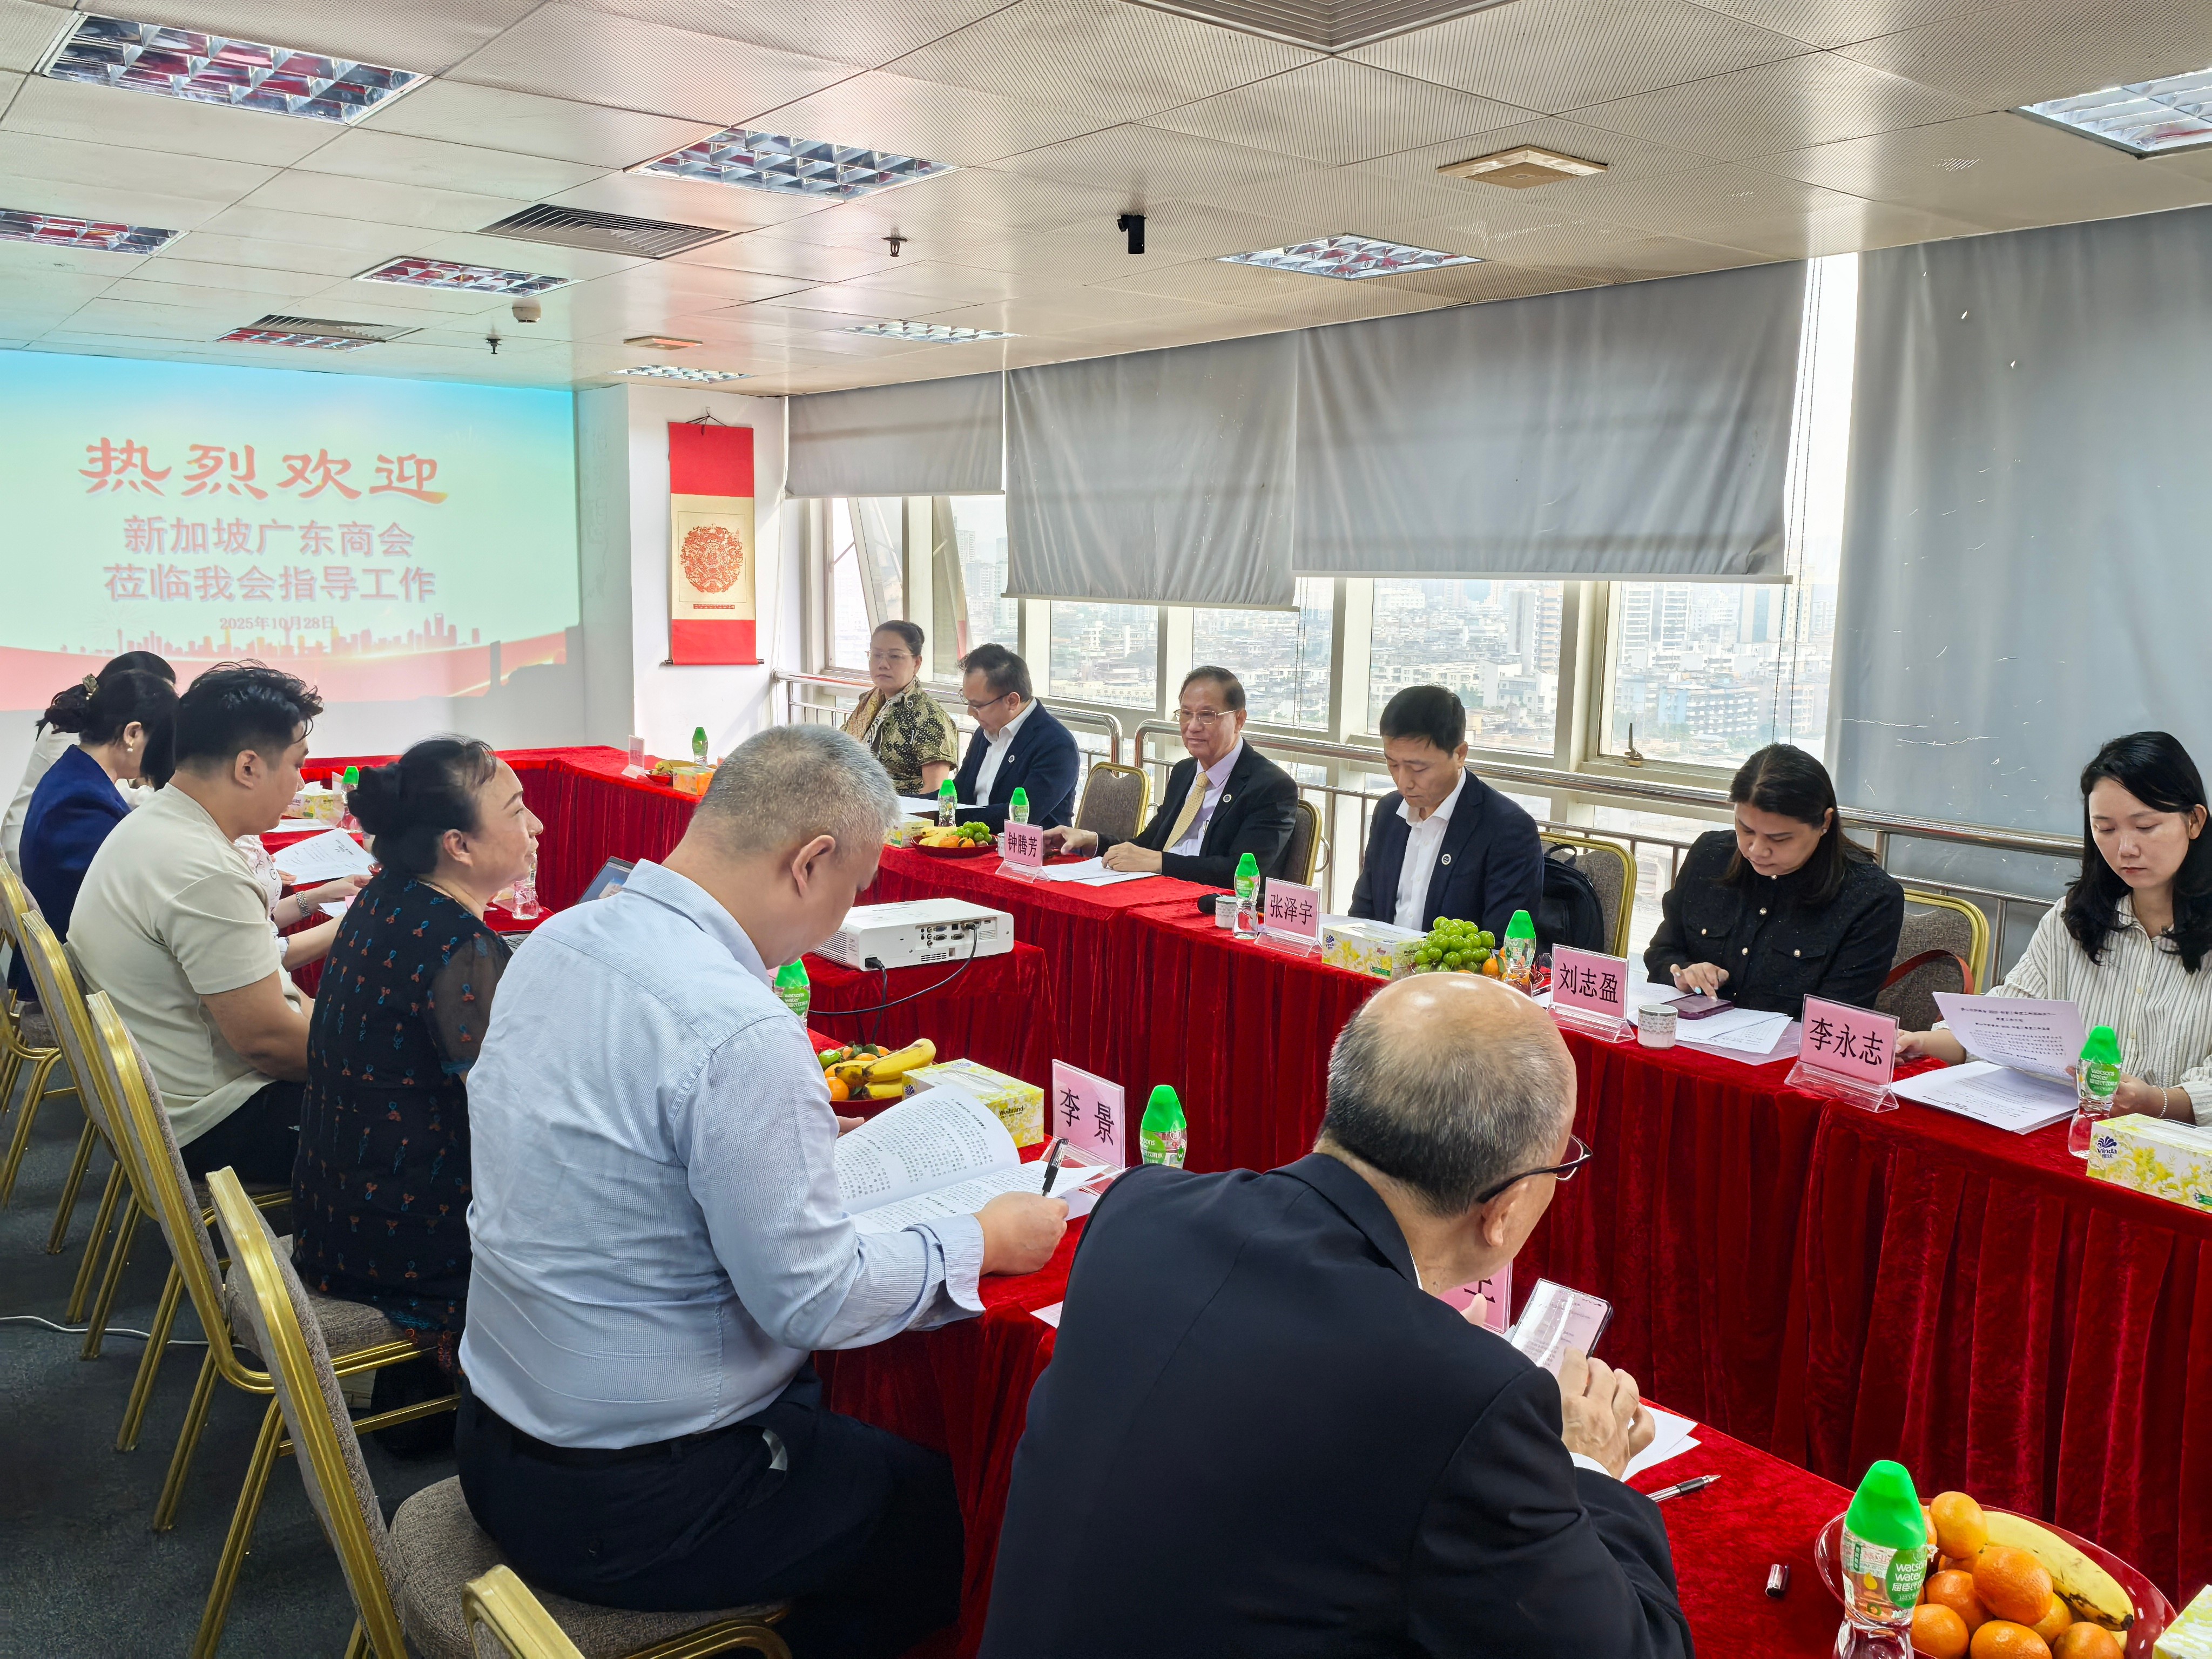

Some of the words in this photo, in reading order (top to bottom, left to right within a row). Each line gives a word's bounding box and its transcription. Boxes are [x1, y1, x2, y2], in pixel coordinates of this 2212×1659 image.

[78, 436, 448, 504] 热烈欢迎
[123, 515, 414, 558] 新加坡广东商会
[103, 563, 436, 604] 莅临我会指导工作
[219, 615, 335, 631] 2025年10月28日
[1008, 832, 1037, 858] 钟腾芳
[1270, 894, 1313, 925] 张泽宇
[1559, 963, 1619, 1004] 刘志盈
[1810, 1017, 1884, 1066] 李永志
[1894, 1571, 1922, 1582] water
